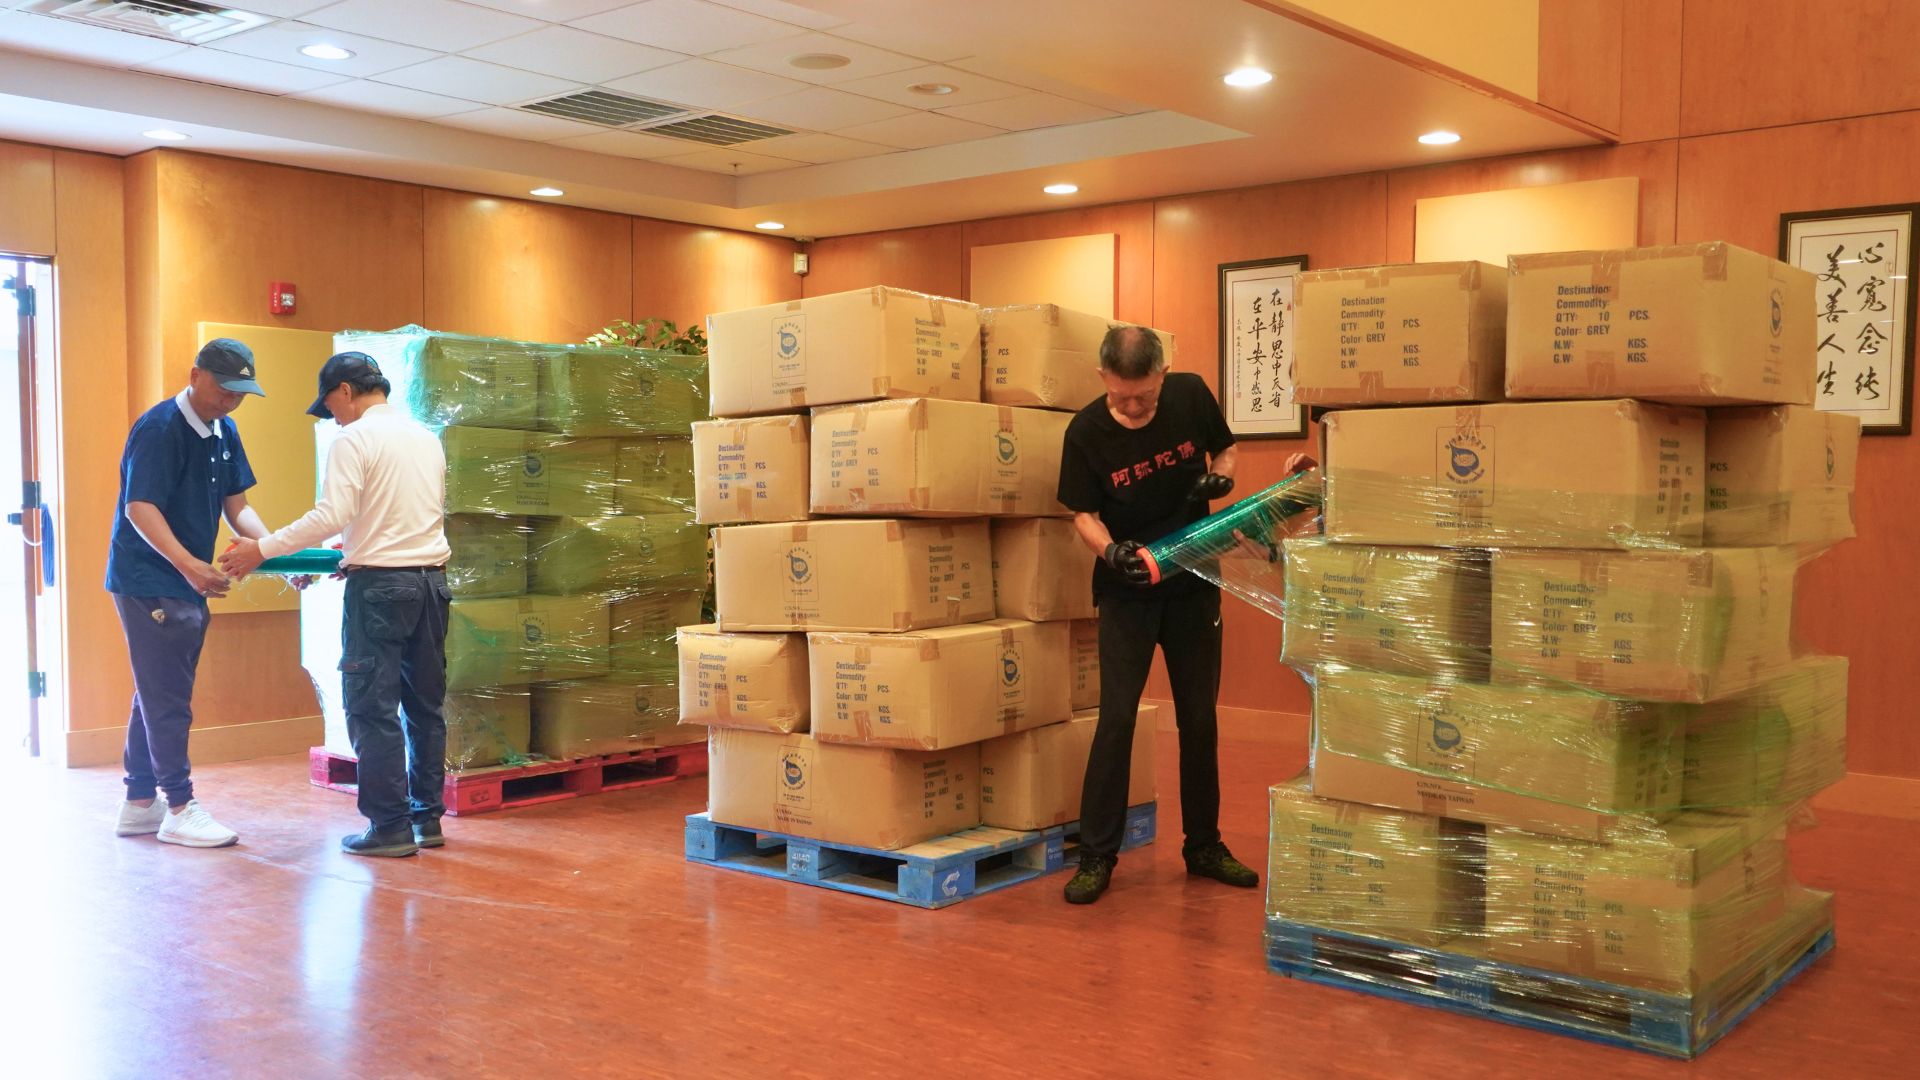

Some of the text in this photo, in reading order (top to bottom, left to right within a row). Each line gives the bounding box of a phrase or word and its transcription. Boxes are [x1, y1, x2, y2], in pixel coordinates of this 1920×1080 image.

[1599, 312, 1610, 322] 10
[1816, 244, 1848, 396] 美善人生
[1376, 321, 1384, 330] 10
[1586, 325, 1610, 336] GREY
[1366, 333, 1386, 342] GREY
